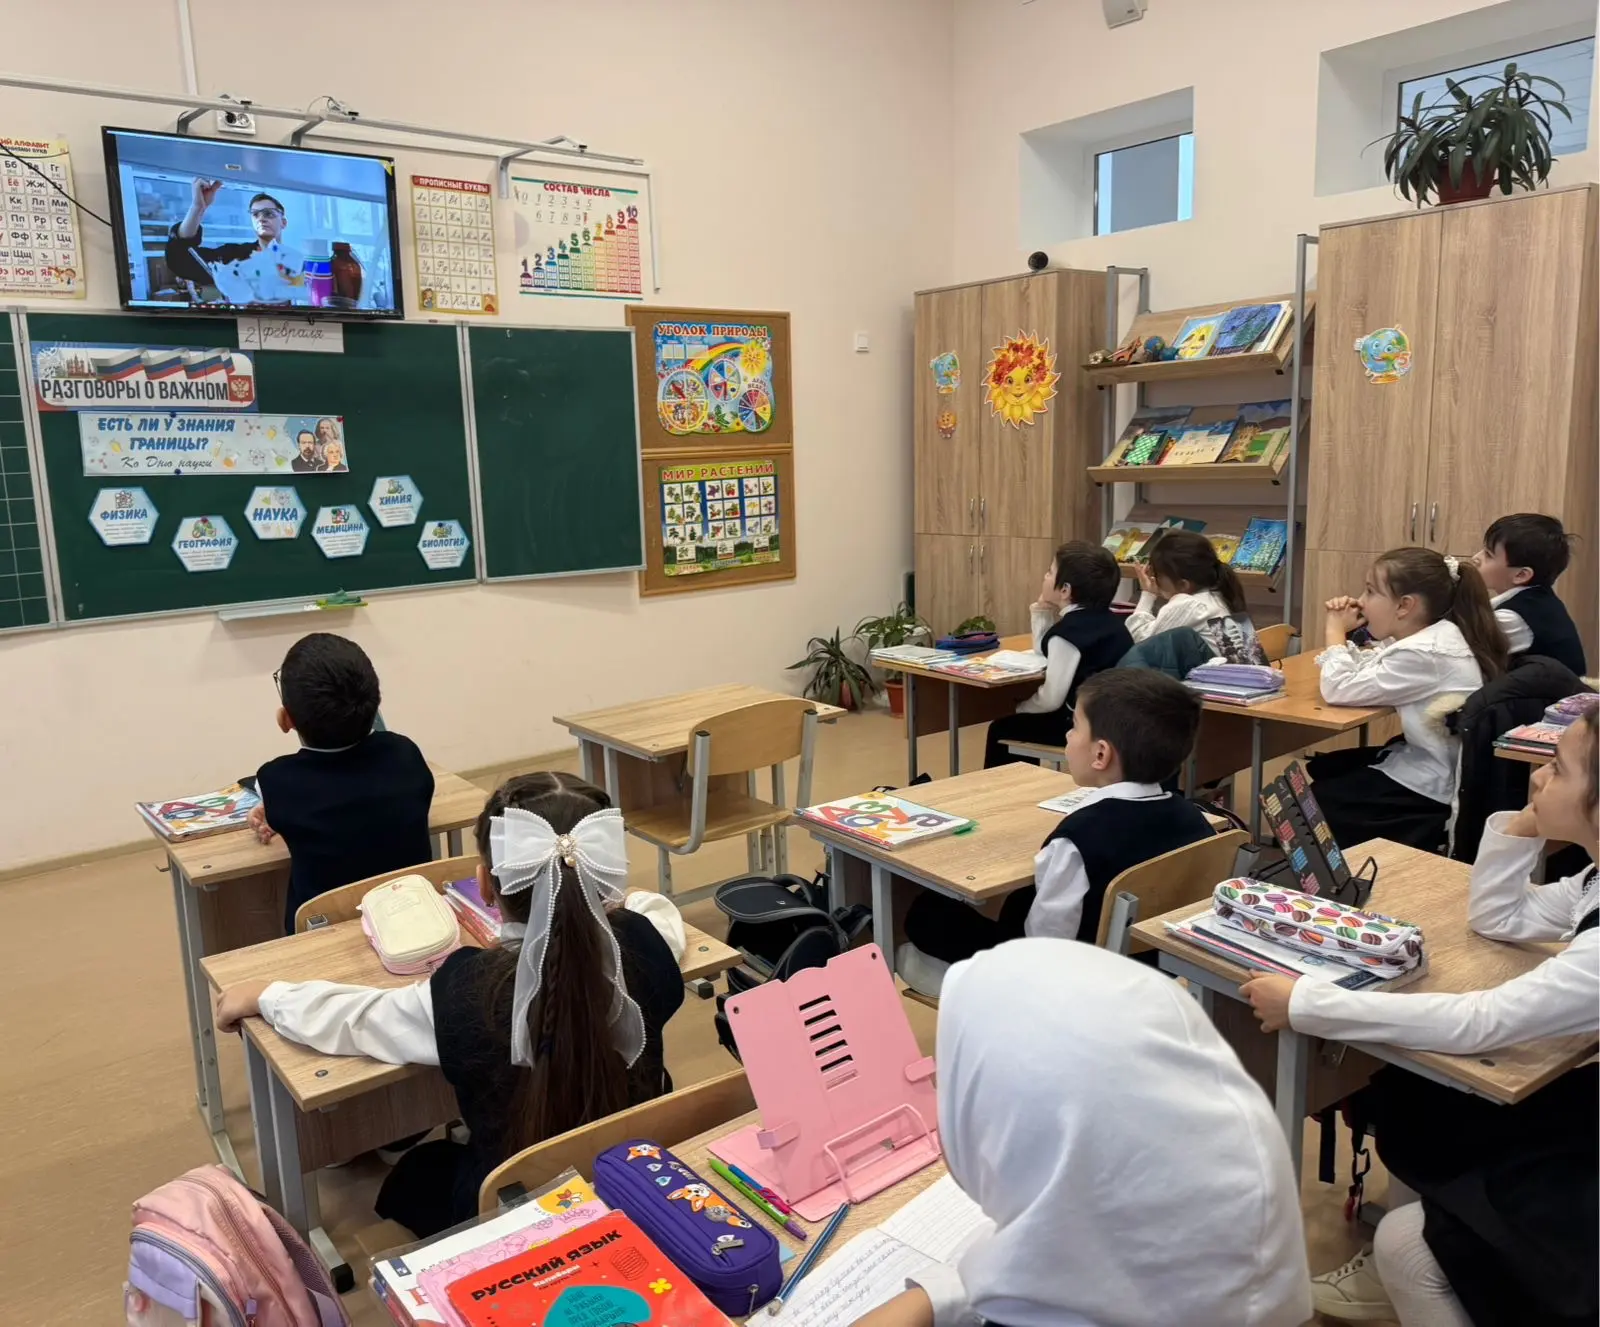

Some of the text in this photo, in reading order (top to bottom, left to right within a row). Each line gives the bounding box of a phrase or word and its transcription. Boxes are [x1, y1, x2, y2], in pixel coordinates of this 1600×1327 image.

[14, 140, 49, 149] АЛФАВИТ
[419, 177, 488, 192] ПРОПИСНЫЕ БУКВЫ
[543, 182, 611, 198] СОСТАВ ЧИСЛА
[617, 210, 625, 225] 9
[626, 205, 638, 218] 10
[606, 214, 613, 230] 8
[570, 232, 579, 247] 5
[582, 228, 590, 242] 6
[547, 246, 555, 260] 3
[558, 239, 567, 253] 4
[521, 258, 528, 272] 1
[534, 252, 542, 267] 2
[245, 320, 324, 344] 2 февраля
[658, 323, 768, 337] УГОЛОК ПРИРОДЫ
[41, 378, 229, 401] РАЗГОВОРЫ О ВАЖНОМ
[98, 417, 235, 433] ЕСТЬ ЛИ У ЗНАНИЯ
[129, 437, 209, 452] ГРАНИЦЫ?
[121, 455, 213, 470] Ко Дню науки
[663, 469, 695, 480] МИР
[379, 494, 412, 506] ХИМИЯ
[100, 508, 148, 521] ФИЗИКА
[252, 507, 298, 522] НАУКА
[316, 523, 364, 534] МЕДИЦИНА
[178, 538, 232, 549] ГЕОГРАФИЯ
[422, 537, 465, 548] БИОЛОГИЯ
[471, 1256, 566, 1301] РУССКИЙ
[566, 1229, 622, 1261] ЯЗЫК
